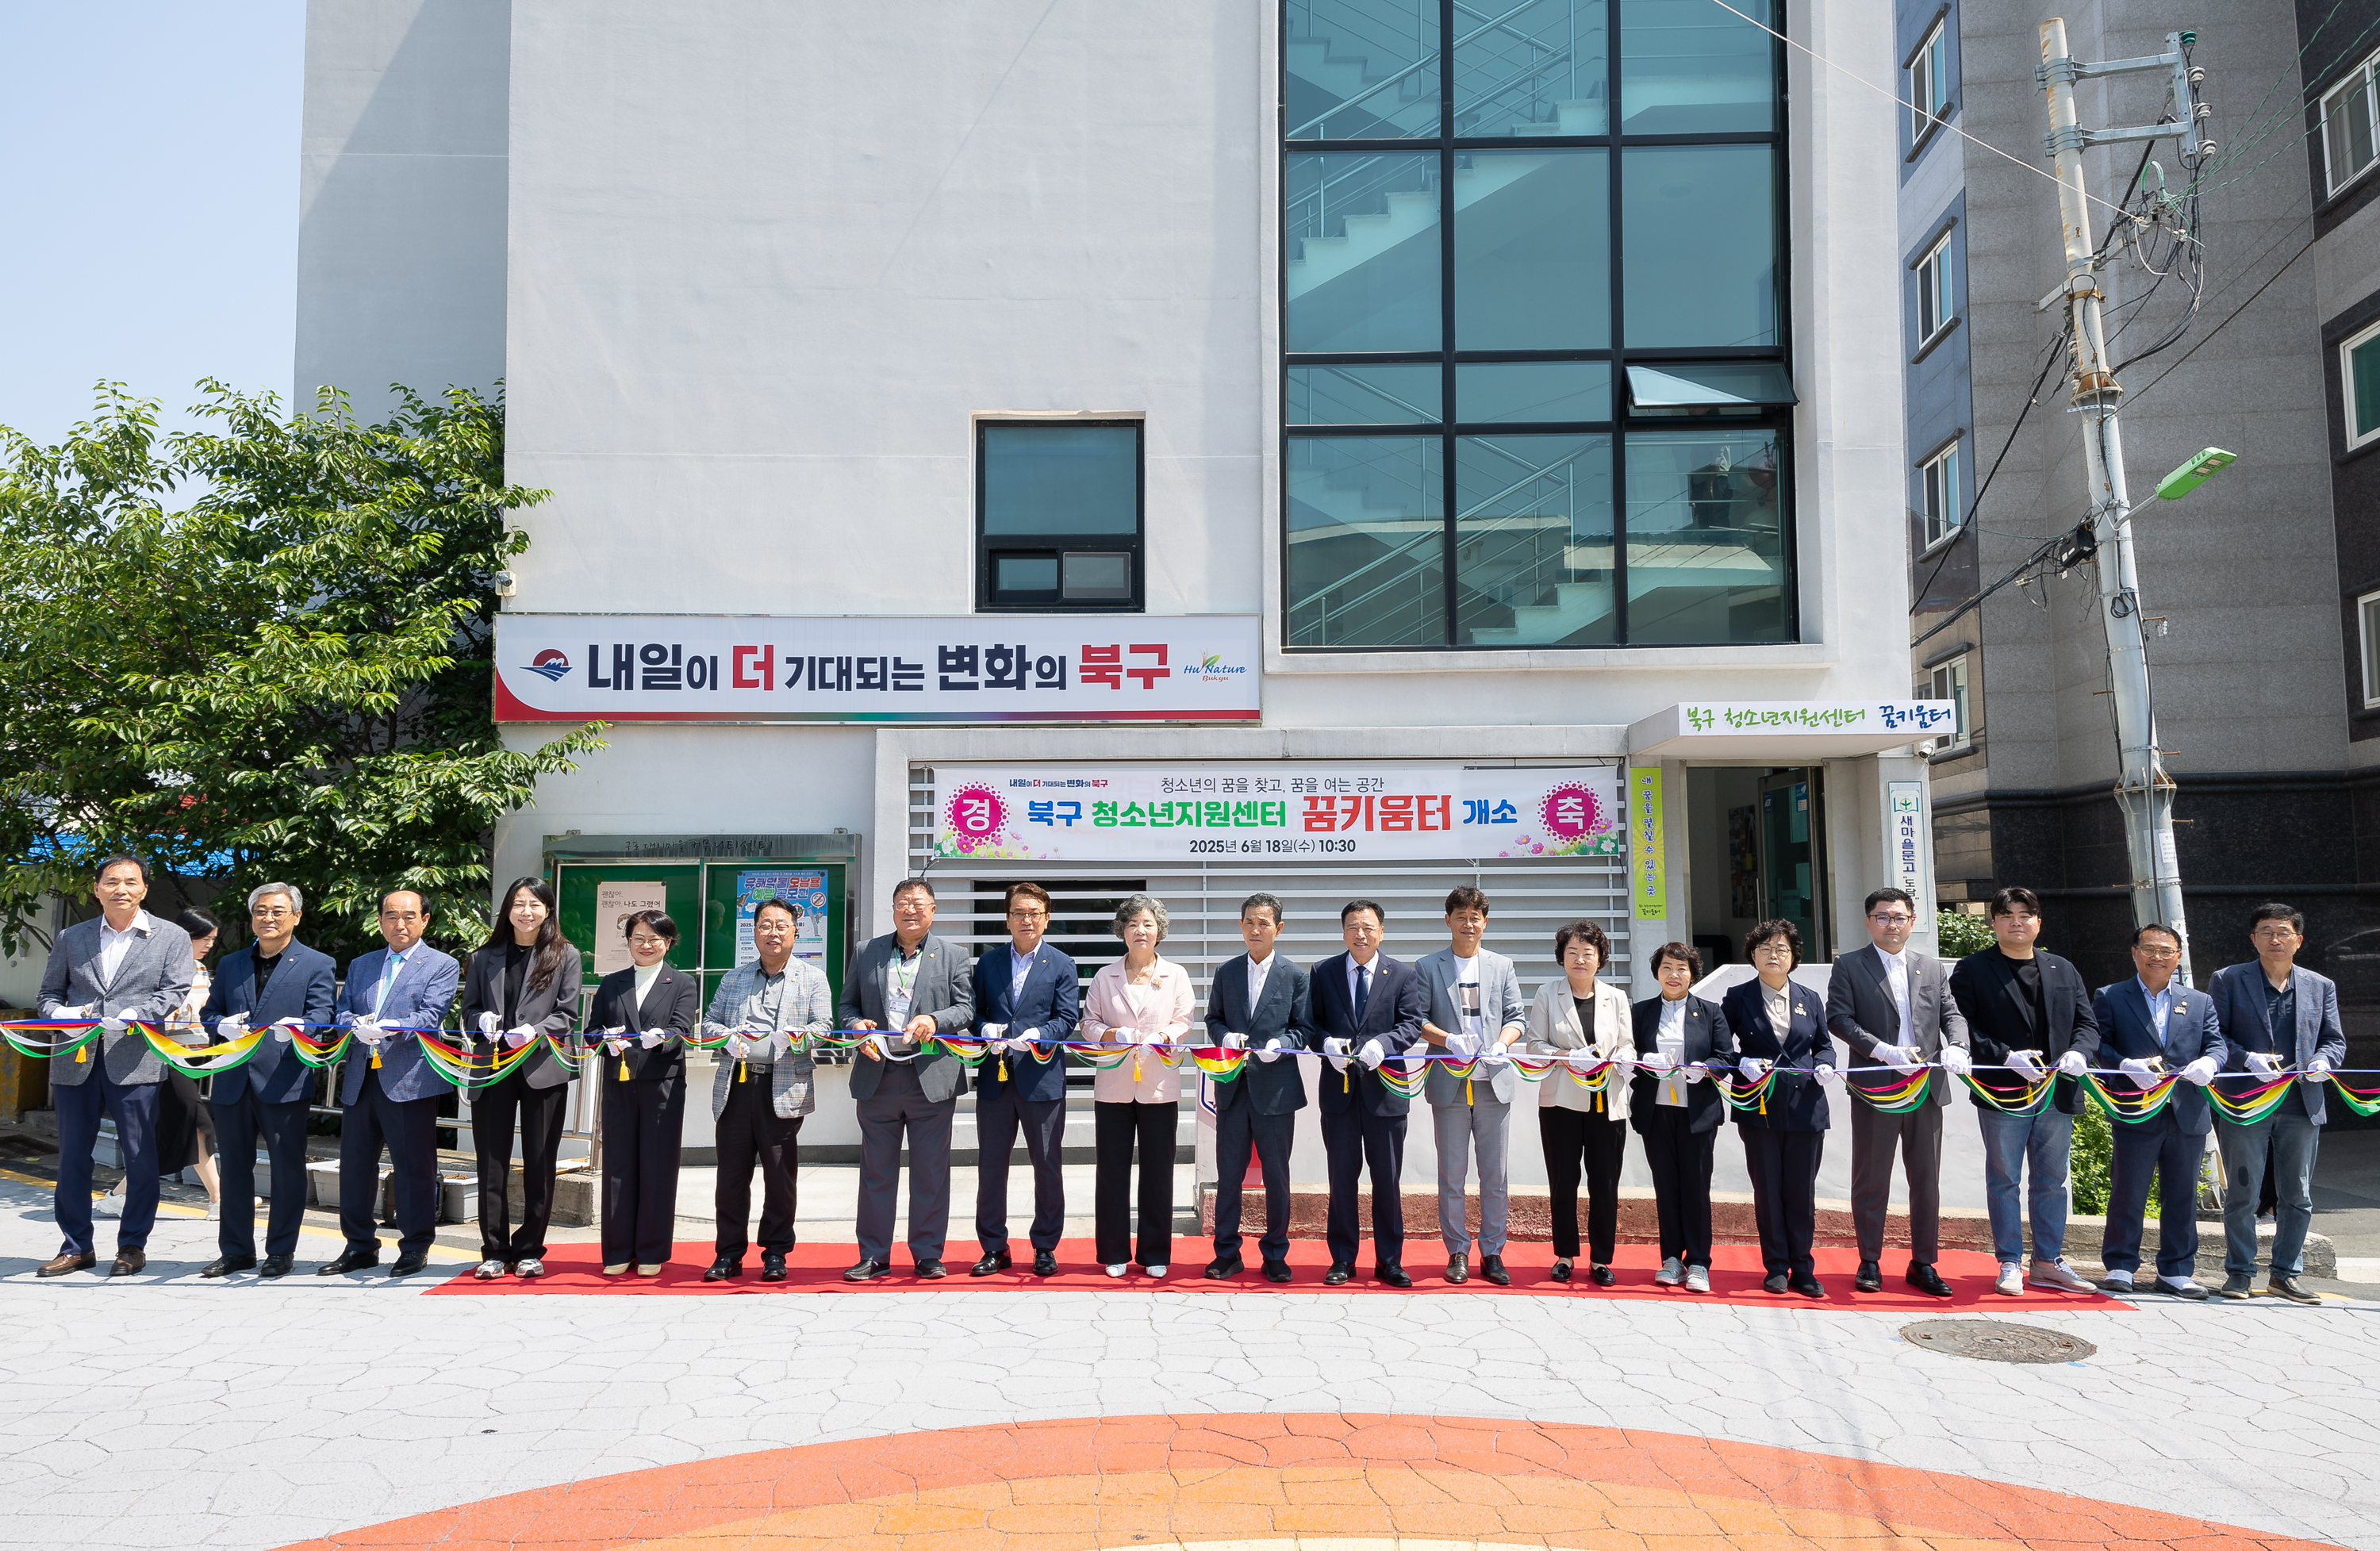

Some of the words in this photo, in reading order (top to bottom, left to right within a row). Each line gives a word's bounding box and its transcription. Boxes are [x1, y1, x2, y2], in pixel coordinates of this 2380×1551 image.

[587, 643, 719, 691] 내일이
[732, 644, 774, 691] 더
[784, 655, 926, 692] 기대되는
[938, 643, 1067, 691] 변화의
[1079, 643, 1171, 690] 북구
[1184, 665, 1202, 674] Hu
[1204, 664, 1247, 674] Nature
[1687, 706, 1715, 731] 북구
[1724, 707, 1865, 728] 청소년지원센터
[1879, 704, 1951, 729] 꿈키움터
[1009, 778, 1032, 787] 내일이
[1066, 779, 1091, 788] 변화의
[1161, 777, 1217, 793] 청소년의
[1221, 777, 1250, 793] 꿈을
[1254, 777, 1286, 794] 찾고,
[1290, 777, 1319, 793] 꿈을
[1324, 777, 1352, 793] 여는
[1356, 777, 1384, 793] 공간
[1641, 776, 1653, 785] 내
[1642, 790, 1653, 814] 꿈을
[961, 798, 991, 831] 경
[1027, 800, 1082, 827] 북구
[1092, 800, 1286, 827] 청소년지원센터
[1302, 795, 1452, 832] 꿈키움터
[1462, 799, 1518, 824] 개소
[1556, 796, 1585, 830] 축
[1643, 817, 1654, 842] 펼칠
[690, 839, 774, 853] 커뮤니티센터
[1189, 839, 1237, 853] 2025년
[1241, 839, 1262, 853] 6월
[1265, 839, 1315, 854] 18일(수)
[1319, 839, 1356, 853] 10:30
[1644, 845, 1655, 854] 수
[1900, 816, 1917, 873] 새마을문고
[1645, 859, 1656, 882] 있는
[744, 876, 789, 889] 유해약물
[789, 876, 821, 889] 오남용
[1645, 885, 1656, 896] 곳
[751, 888, 776, 900] 예방
